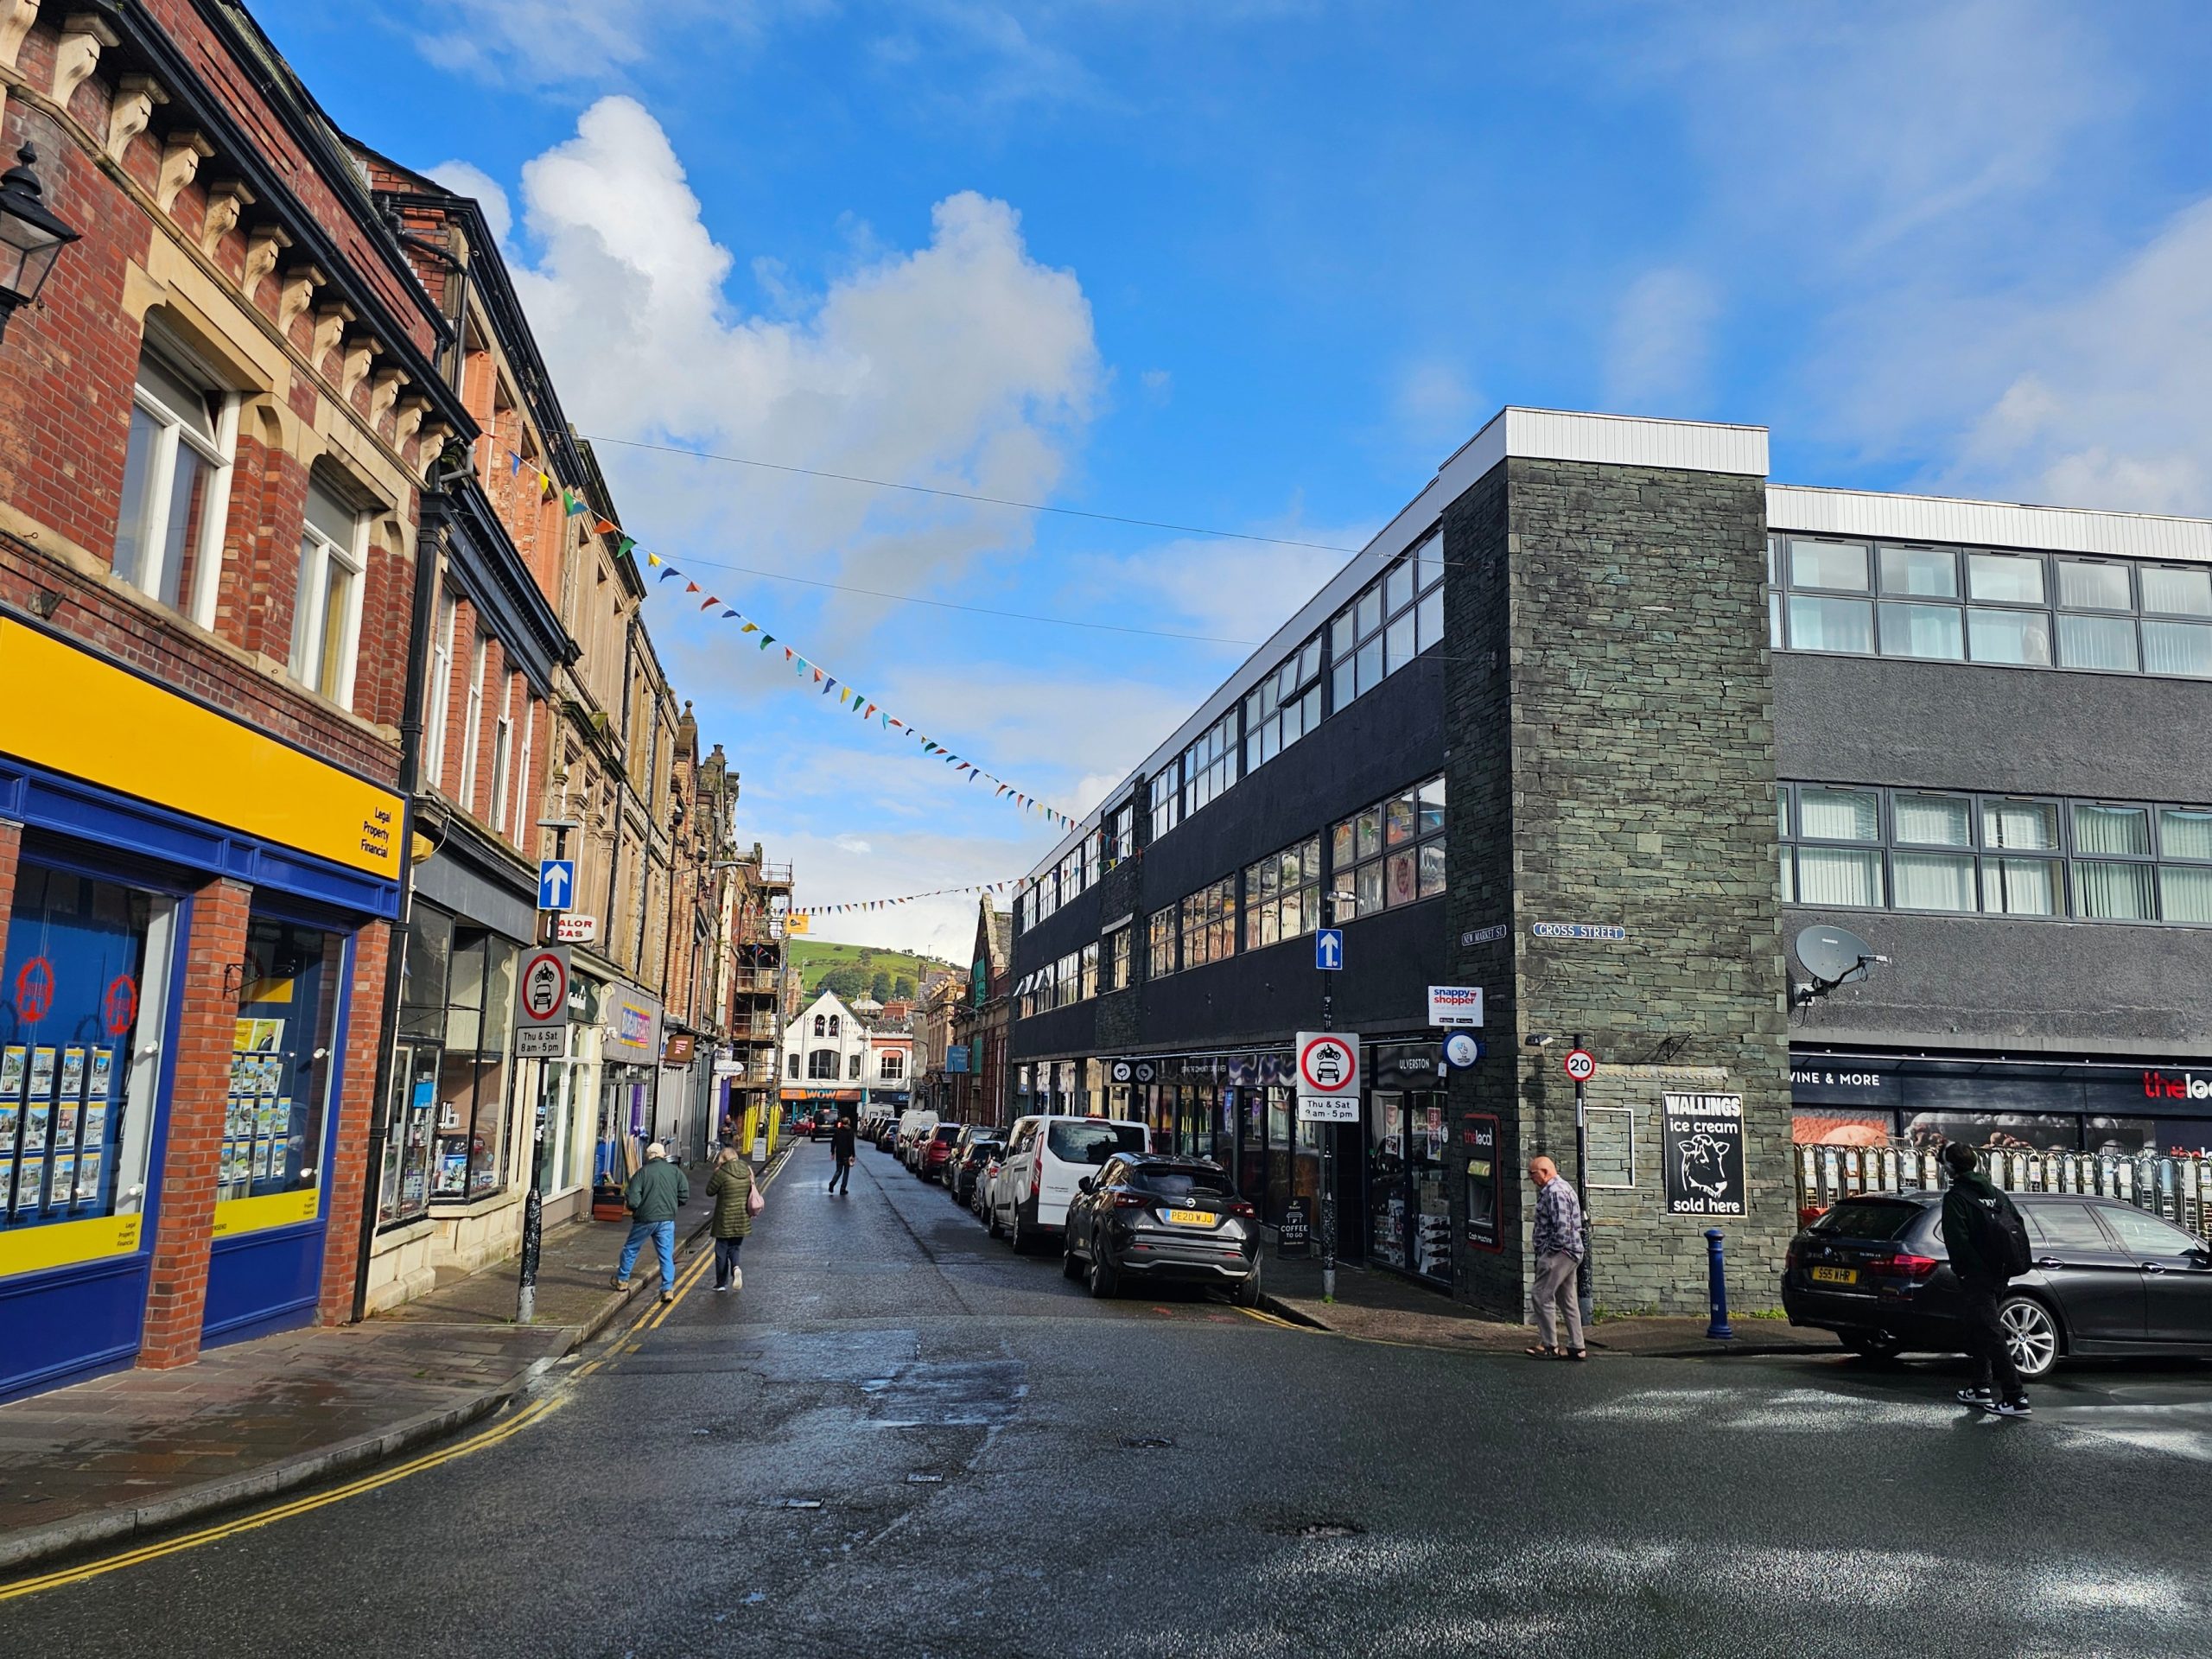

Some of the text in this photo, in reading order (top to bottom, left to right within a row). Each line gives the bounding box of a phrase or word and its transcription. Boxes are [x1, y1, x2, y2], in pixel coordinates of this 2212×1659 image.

[375, 806, 391, 823] Legal
[364, 820, 390, 843] Property
[361, 838, 388, 858] Financial
[558, 918, 593, 929] ALOR
[1464, 926, 1504, 944] NEW MARKET ST.
[1539, 925, 1620, 938] CROSS STREET
[1433, 988, 1470, 998] snappy
[1433, 995, 1476, 1006] shopper
[524, 1031, 557, 1040] Thu & Sat
[542, 1042, 547, 1052] 5
[548, 1044, 559, 1053] pm
[1400, 1058, 1430, 1070] ULVERSTON
[1569, 1058, 1590, 1071] 20
[1825, 1073, 1834, 1084] &
[1840, 1074, 1880, 1086] MORE
[806, 1089, 837, 1099] WOW
[1664, 1095, 1741, 1117] WALLINGS
[1669, 1117, 1738, 1134] ice cream
[1674, 1198, 1740, 1213] sold here
[1172, 1211, 1212, 1224] PE20 WJJ
